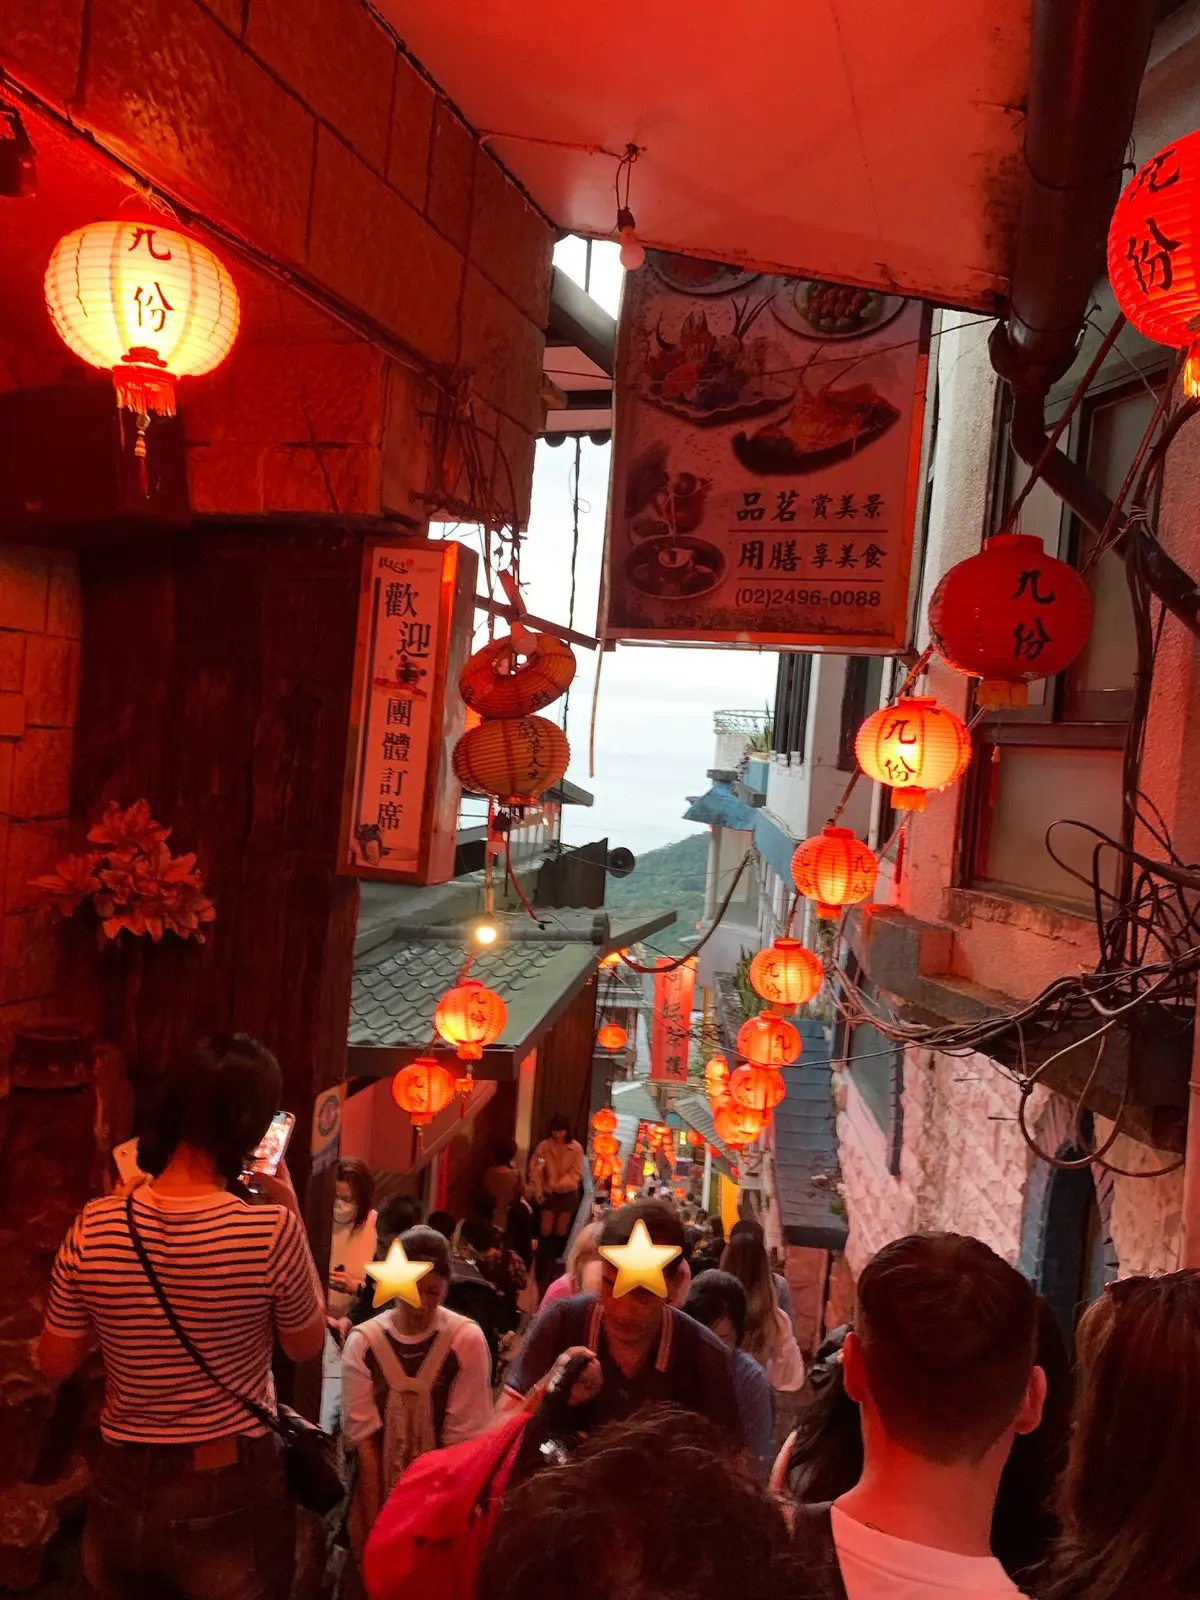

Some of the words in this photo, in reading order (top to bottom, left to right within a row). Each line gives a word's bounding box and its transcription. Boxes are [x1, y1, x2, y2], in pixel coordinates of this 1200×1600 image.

[1125, 148, 1183, 296] 九份
[128, 226, 175, 333] 九份
[736, 490, 799, 522] 品茗
[811, 493, 885, 520] 賞美景
[736, 539, 802, 572] 用膳
[811, 542, 887, 570] 享美食
[385, 581, 431, 659] 歡迎
[735, 588, 881, 608] (02)2496-0088
[1011, 569, 1056, 662] 九份
[378, 698, 413, 831] 團體訂席
[884, 719, 918, 783] 九份
